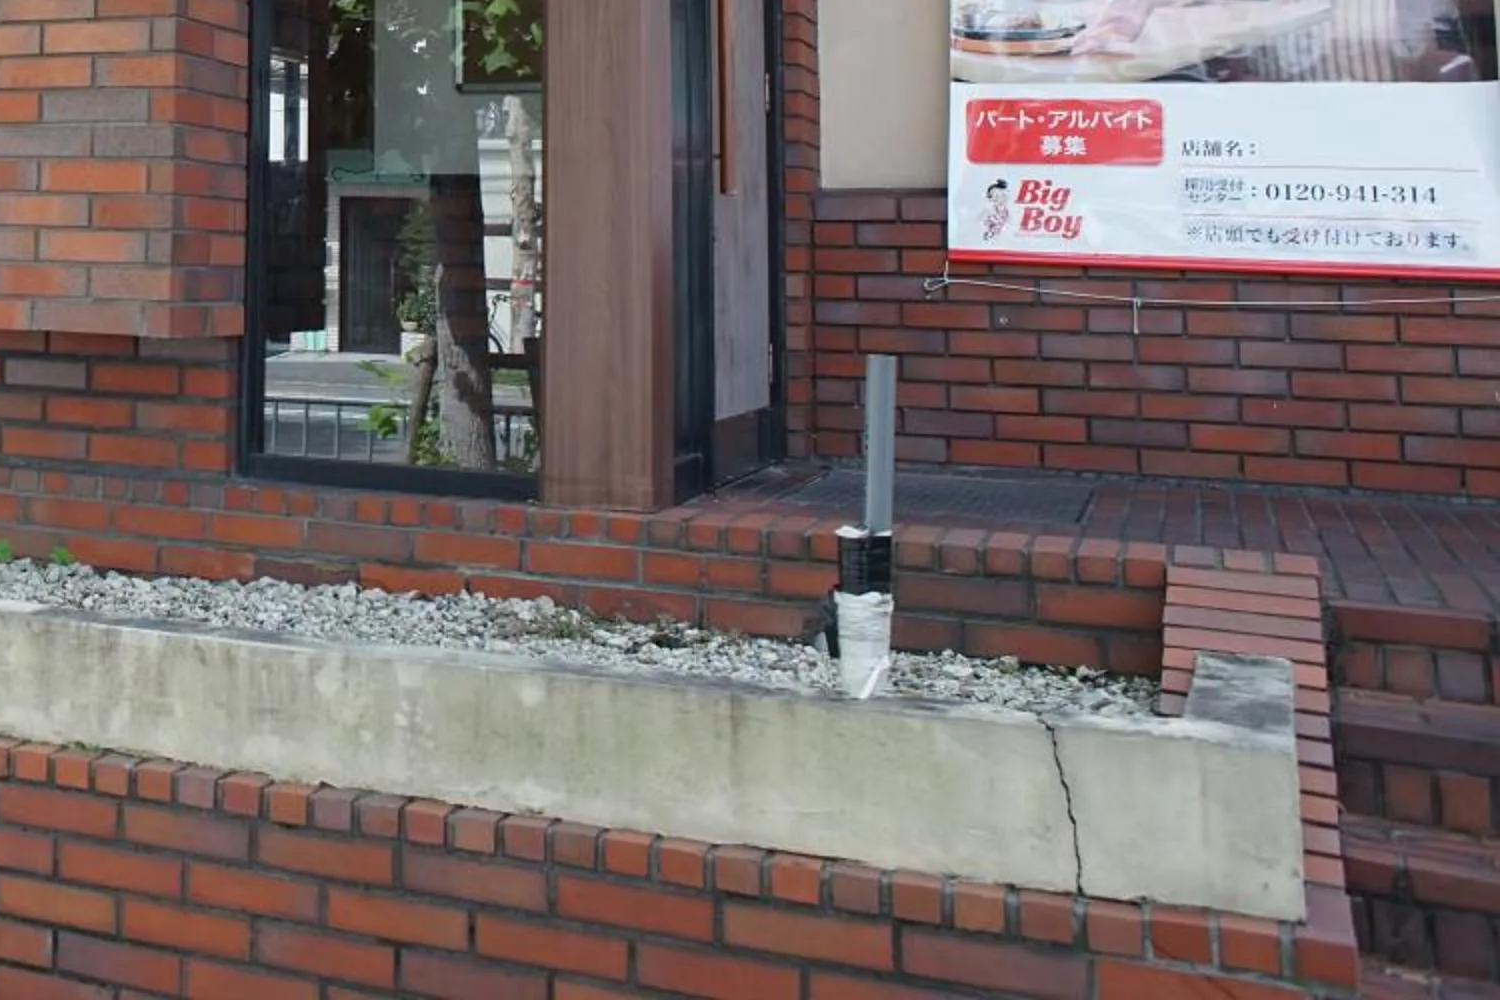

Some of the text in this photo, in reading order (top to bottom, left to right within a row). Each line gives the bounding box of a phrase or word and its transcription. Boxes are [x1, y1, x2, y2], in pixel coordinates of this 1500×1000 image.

[975, 109, 1153, 131] パート・アルバイト
[1040, 134, 1088, 157] 募集
[1014, 179, 1071, 212] Big
[1019, 207, 1082, 239] Boy
